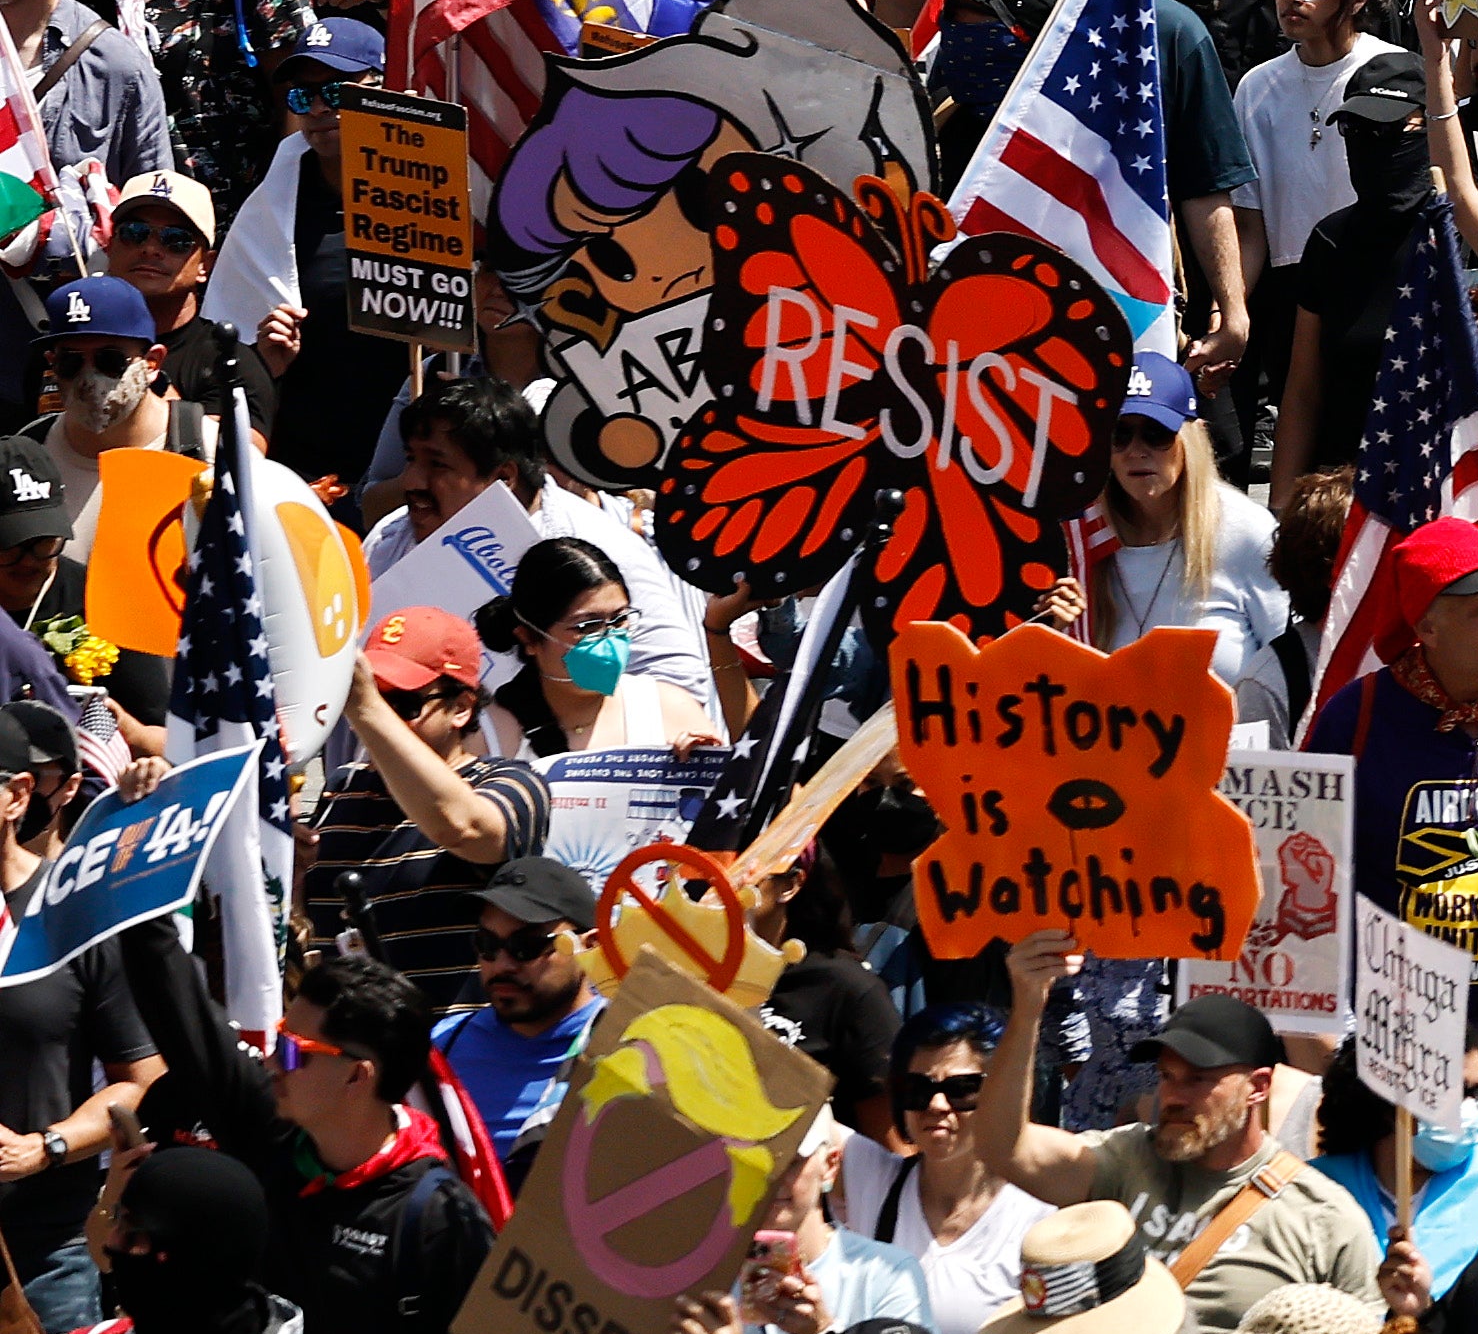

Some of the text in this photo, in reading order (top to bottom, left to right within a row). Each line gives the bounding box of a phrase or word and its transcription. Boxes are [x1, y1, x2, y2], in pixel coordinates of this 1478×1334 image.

[380, 122, 425, 150] The
[359, 146, 449, 187] Trump
[351, 179, 459, 219] Fascist
[352, 214, 462, 255] Regime
[351, 258, 469, 297] MUST GO
[361, 287, 463, 331] NOW!!!
[760, 285, 1079, 511] RESIST
[908, 675, 1186, 779] History
[958, 777, 1005, 832] is
[937, 847, 1226, 959] Watching
